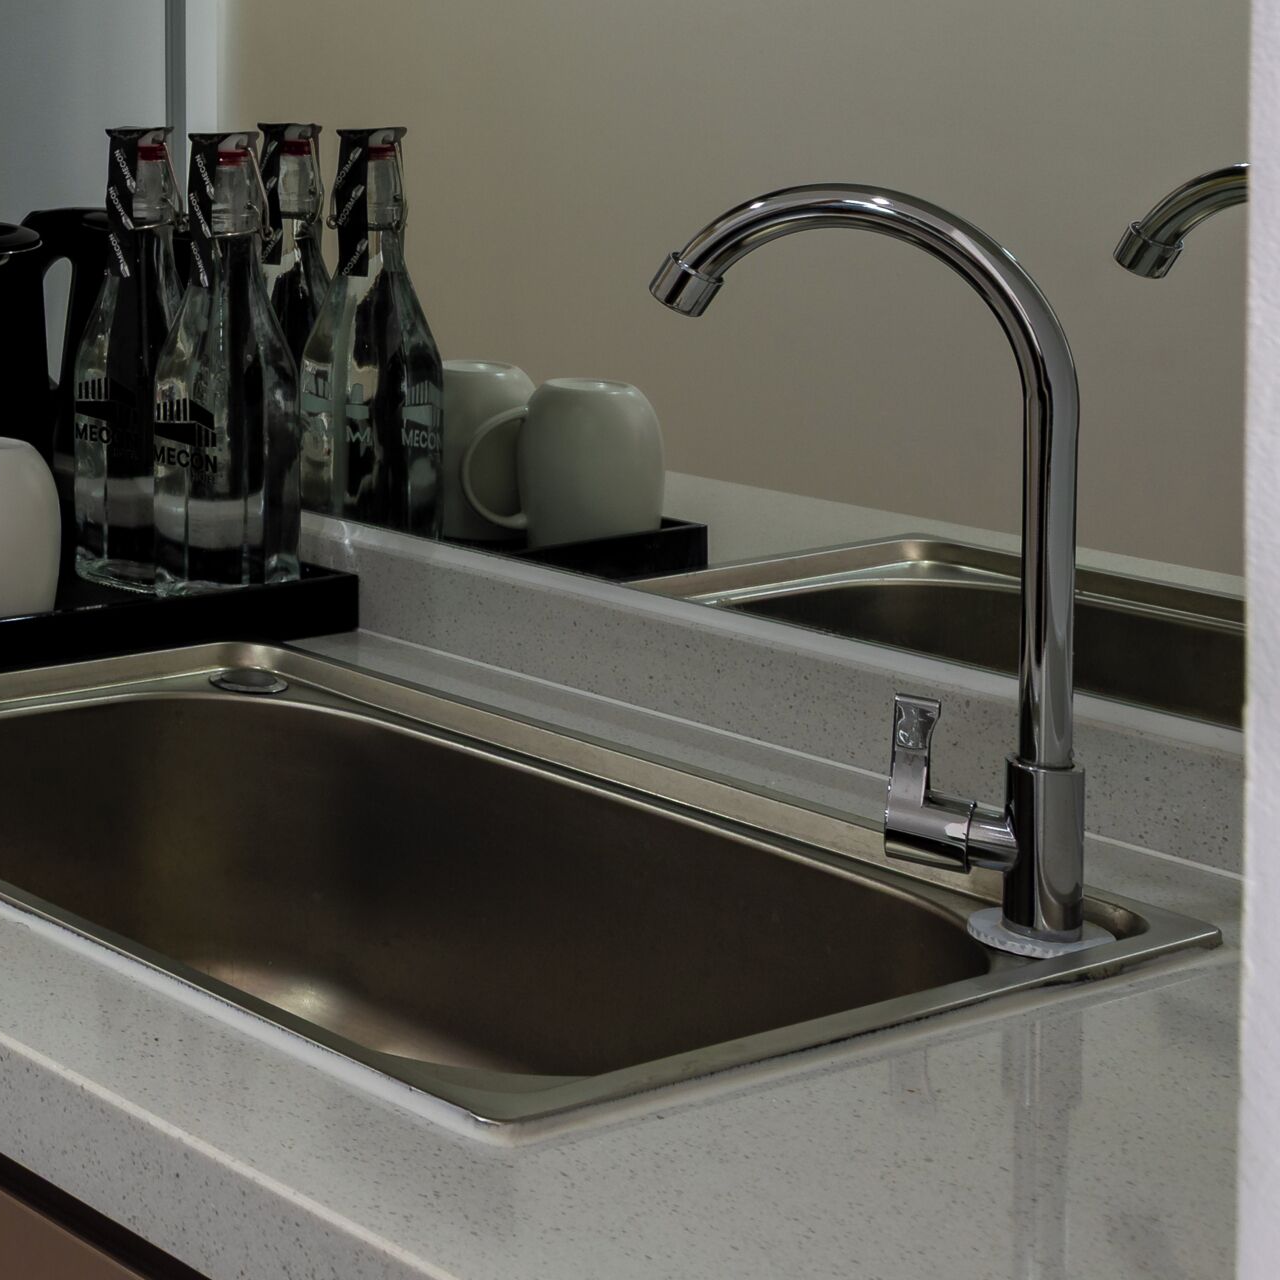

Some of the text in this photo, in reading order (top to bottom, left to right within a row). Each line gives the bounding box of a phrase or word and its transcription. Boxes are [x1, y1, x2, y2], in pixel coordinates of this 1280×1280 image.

[114, 148, 132, 179] MECON
[194, 154, 211, 185] MECON
[108, 186, 125, 216] MECON
[189, 192, 207, 225] MECON
[108, 233, 126, 266] MECON
[190, 241, 205, 273] MECON
[153, 445, 217, 473] MECON
